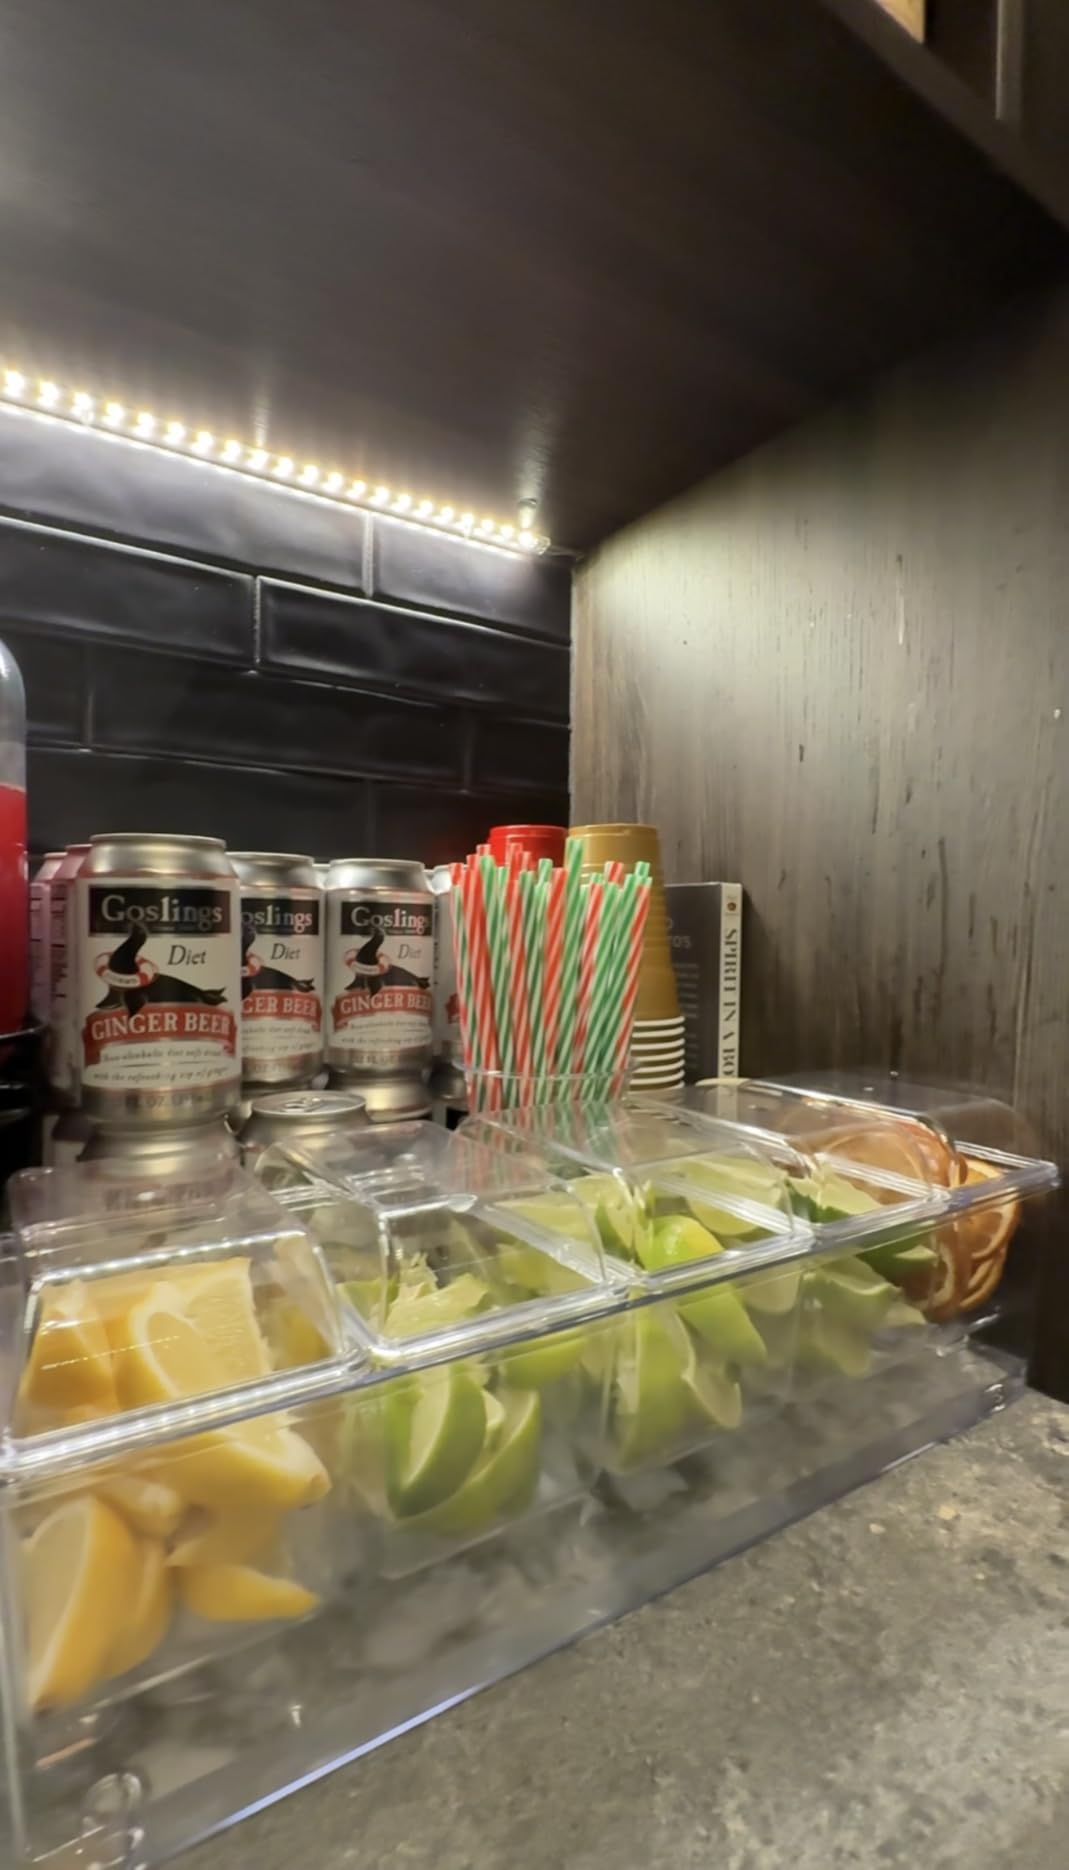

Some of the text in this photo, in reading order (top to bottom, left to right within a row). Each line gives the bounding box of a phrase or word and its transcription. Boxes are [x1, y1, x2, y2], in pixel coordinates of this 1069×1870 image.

[101, 894, 223, 931] Goslings
[241, 904, 313, 933] oslings
[167, 944, 207, 966] Diet
[270, 942, 301, 961] Diet
[723, 928, 738, 992] SPIRIT
[282, 997, 317, 1018] BEER
[339, 993, 404, 1015] GINGER
[722, 1001, 737, 1022] IN
[91, 1011, 231, 1041] GINGER BEER
